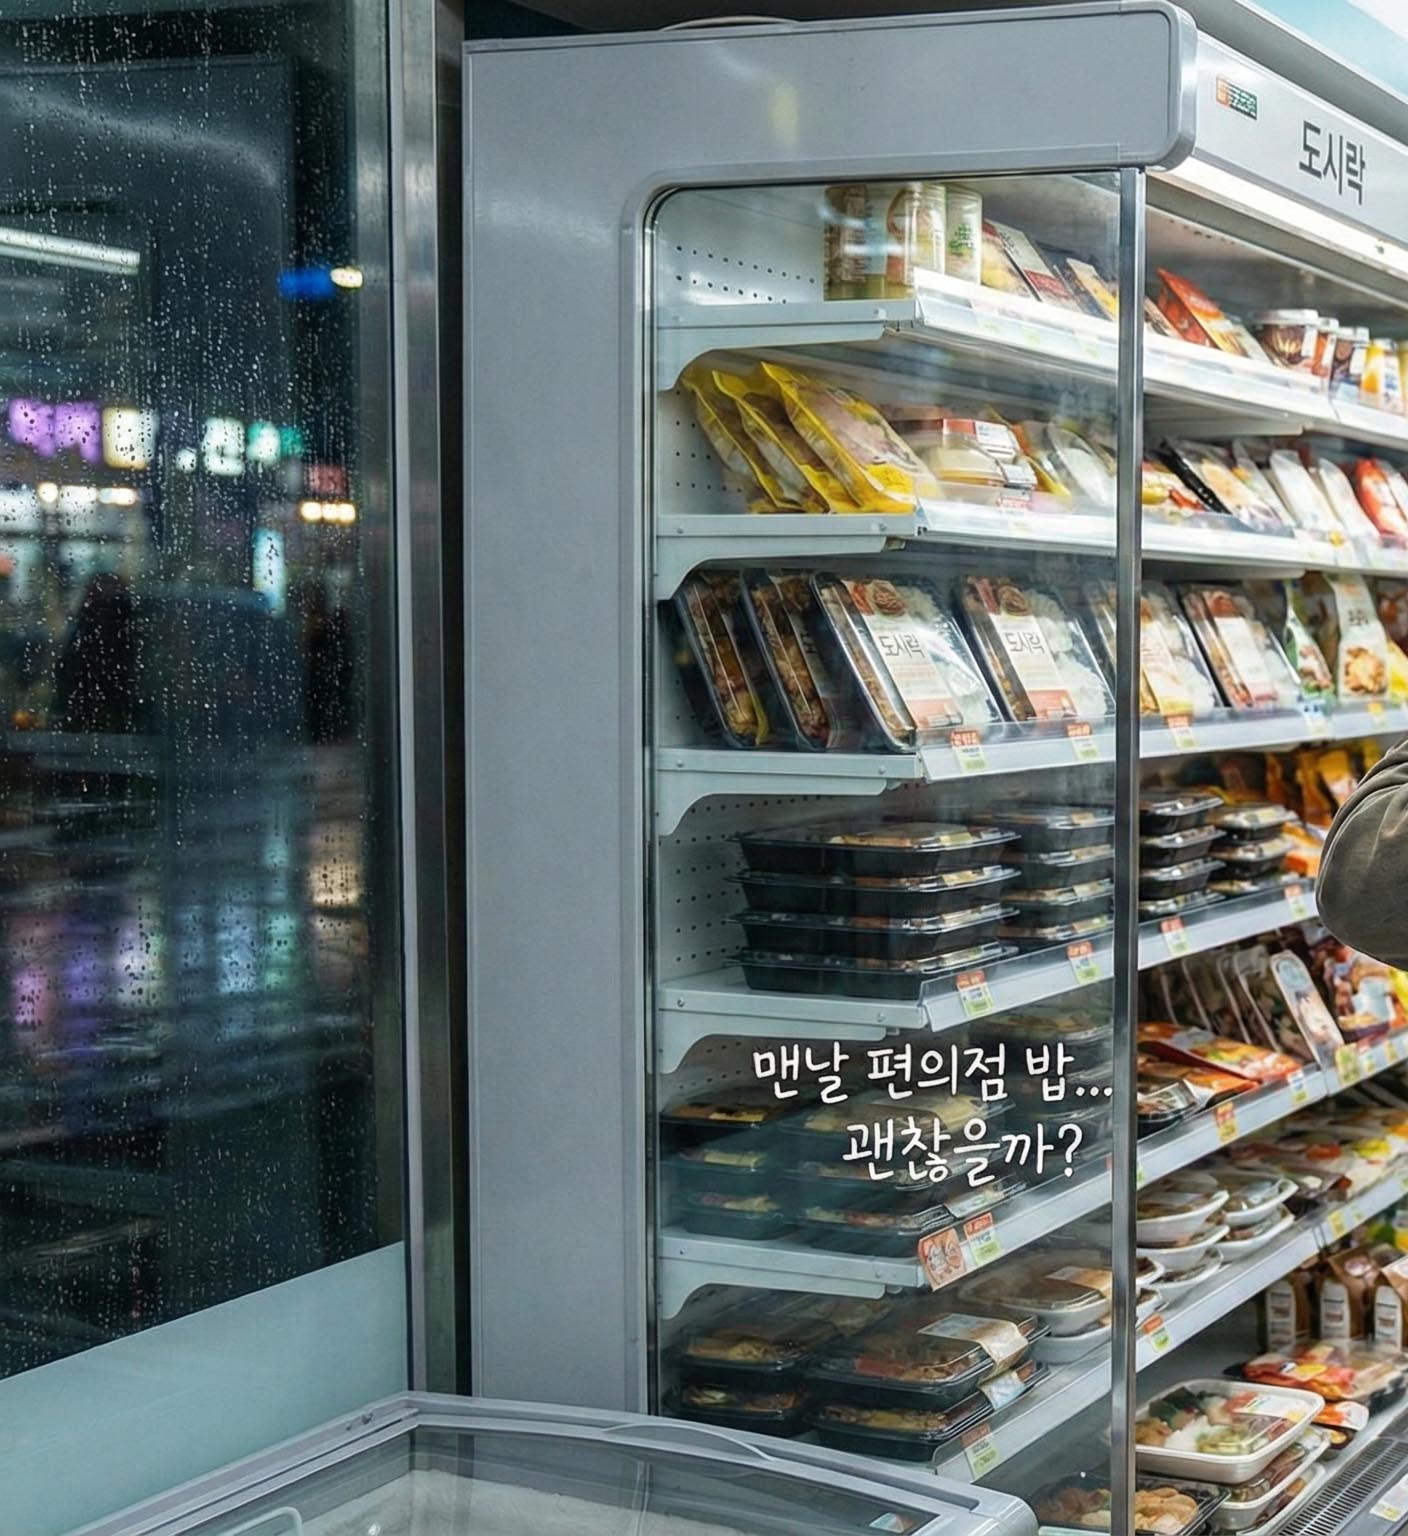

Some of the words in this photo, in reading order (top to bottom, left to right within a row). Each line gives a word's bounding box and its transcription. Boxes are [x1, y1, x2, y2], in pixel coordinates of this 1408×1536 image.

[1299, 120, 1366, 206] 도시락
[879, 633, 926, 659] 도시락
[1004, 631, 1045, 655] 도시락
